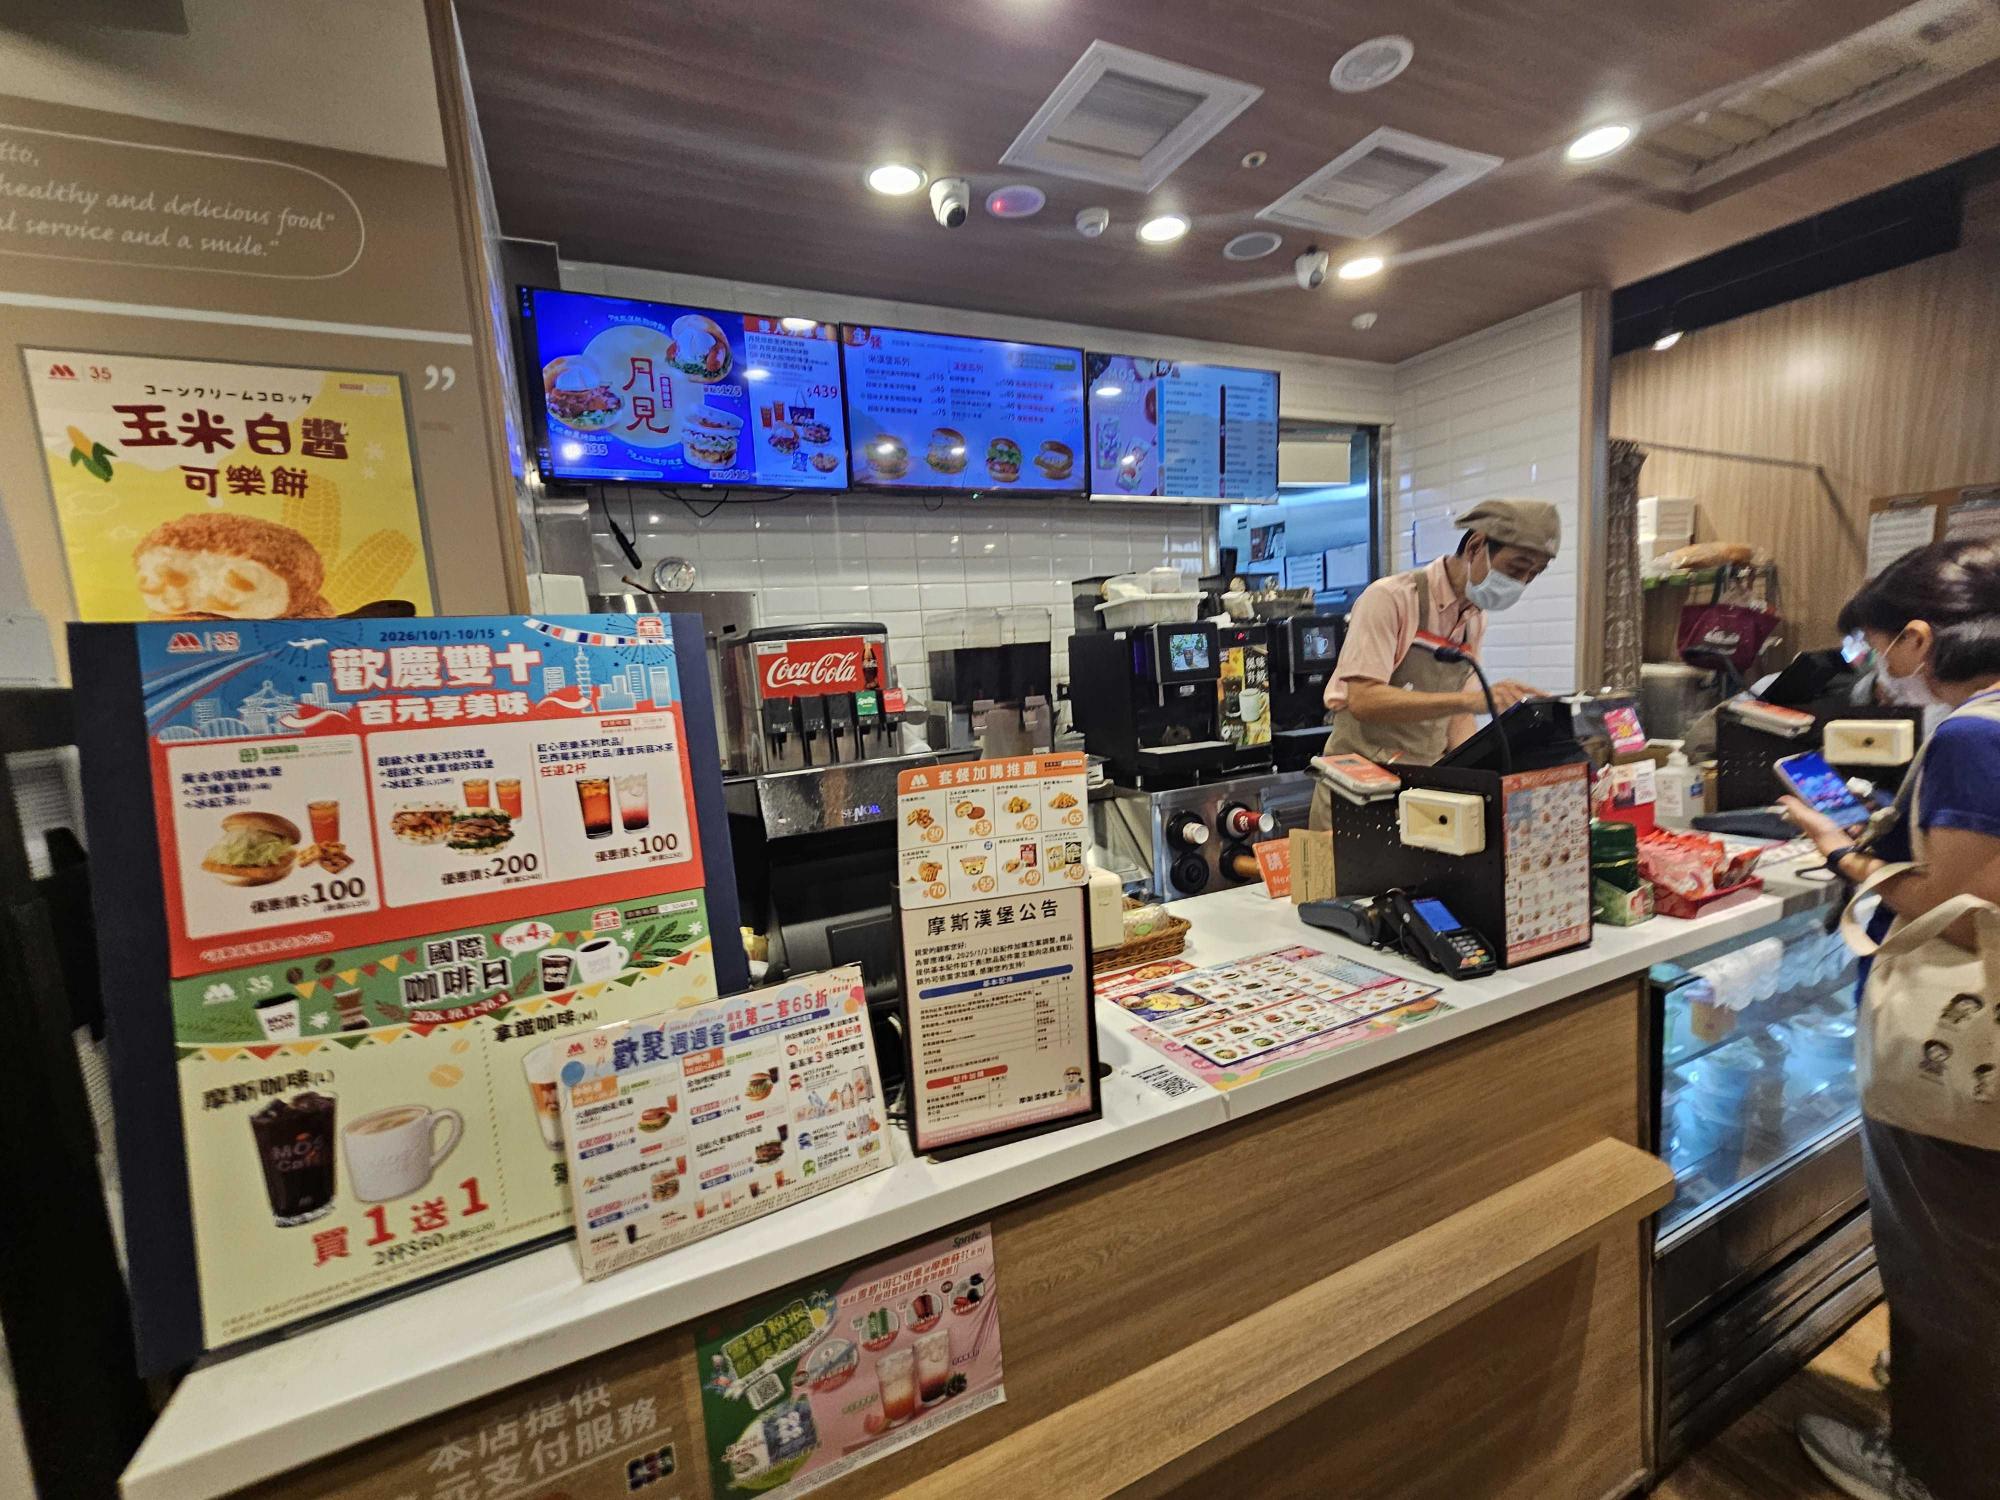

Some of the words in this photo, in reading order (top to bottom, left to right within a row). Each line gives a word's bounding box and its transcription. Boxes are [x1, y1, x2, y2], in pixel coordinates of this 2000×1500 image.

[0, 173, 99, 215] healthy
[106, 192, 156, 212] and
[26, 219, 115, 241] service
[121, 226, 171, 247] and
[177, 235, 192, 249] a
[144, 384, 313, 405] コーンクリームコロッケ
[622, 356, 670, 434] 月見
[112, 404, 349, 460] 玉米白醬
[179, 465, 310, 499] 可樂餅
[329, 642, 543, 694] 歡慶雙十
[766, 651, 859, 688] Coca-Cola
[358, 691, 530, 727] 百元享美味
[540, 762, 587, 778] 任選2杯
[938, 761, 1038, 785] 套餐加購推薦
[927, 899, 1058, 937] 摩斯漢堡公告
[424, 934, 487, 970] 國際
[401, 957, 512, 1009] 咖啡日
[744, 988, 828, 1026] 第二套65折
[398, 1396, 658, 1500] 元支付服務
[428, 1384, 611, 1474] 本店提供
